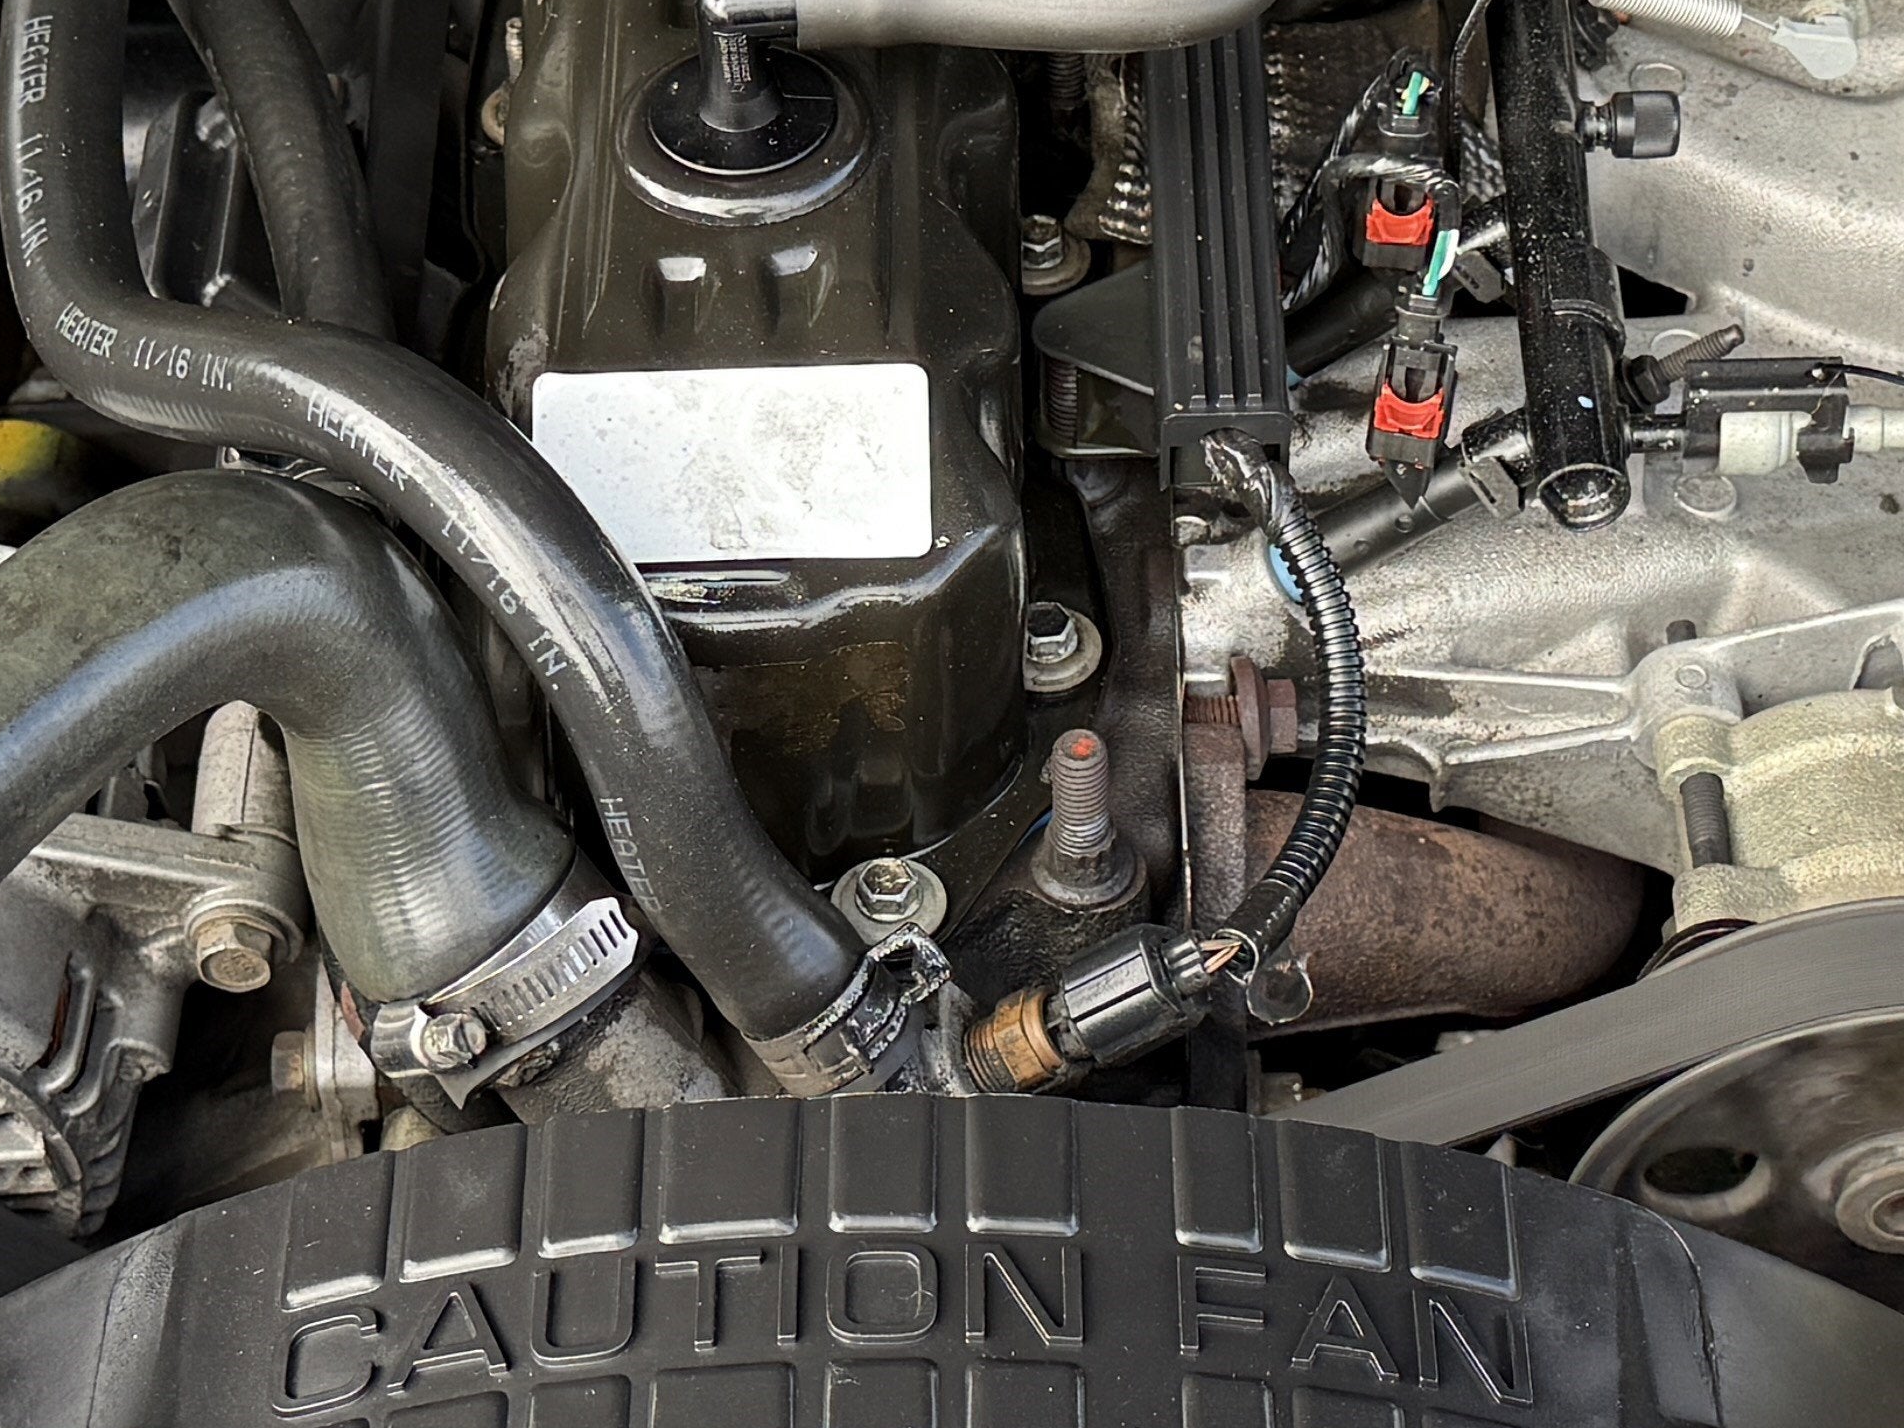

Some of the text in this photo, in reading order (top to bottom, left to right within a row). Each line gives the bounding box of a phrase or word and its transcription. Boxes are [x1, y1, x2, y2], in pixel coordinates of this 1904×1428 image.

[15, 132, 44, 214] 11/16
[20, 217, 50, 268] IN.
[54, 301, 119, 359] HEATER
[132, 335, 193, 380] 11/16
[201, 352, 233, 392] IN.
[307, 388, 411, 493] HEATER
[441, 517, 519, 618] 11/16
[527, 629, 569, 692] IN.
[599, 796, 667, 916] HEATER
[270, 1240, 1535, 1420] CAUTION FAN
